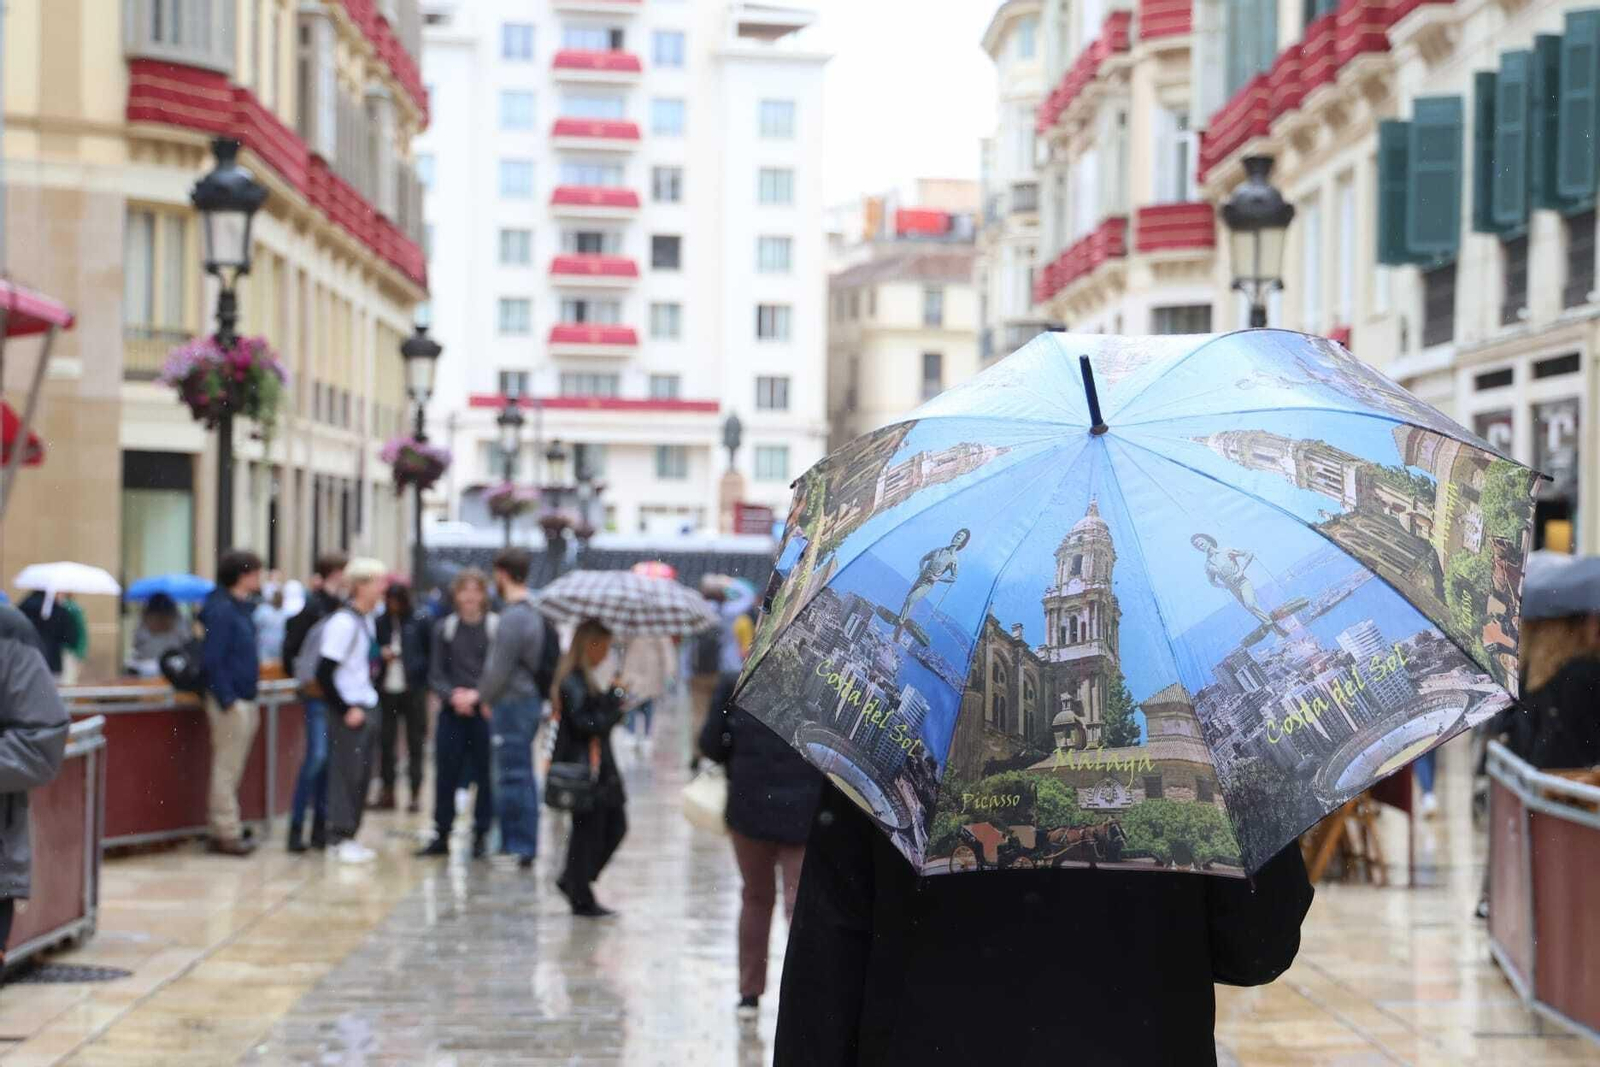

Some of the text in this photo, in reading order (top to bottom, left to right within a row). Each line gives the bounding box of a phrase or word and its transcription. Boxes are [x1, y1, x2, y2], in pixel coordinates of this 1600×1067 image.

[816, 659, 921, 757] Costa del Sol
[1266, 642, 1408, 743] Costa del Sol
[961, 793, 1020, 814] Picasso
